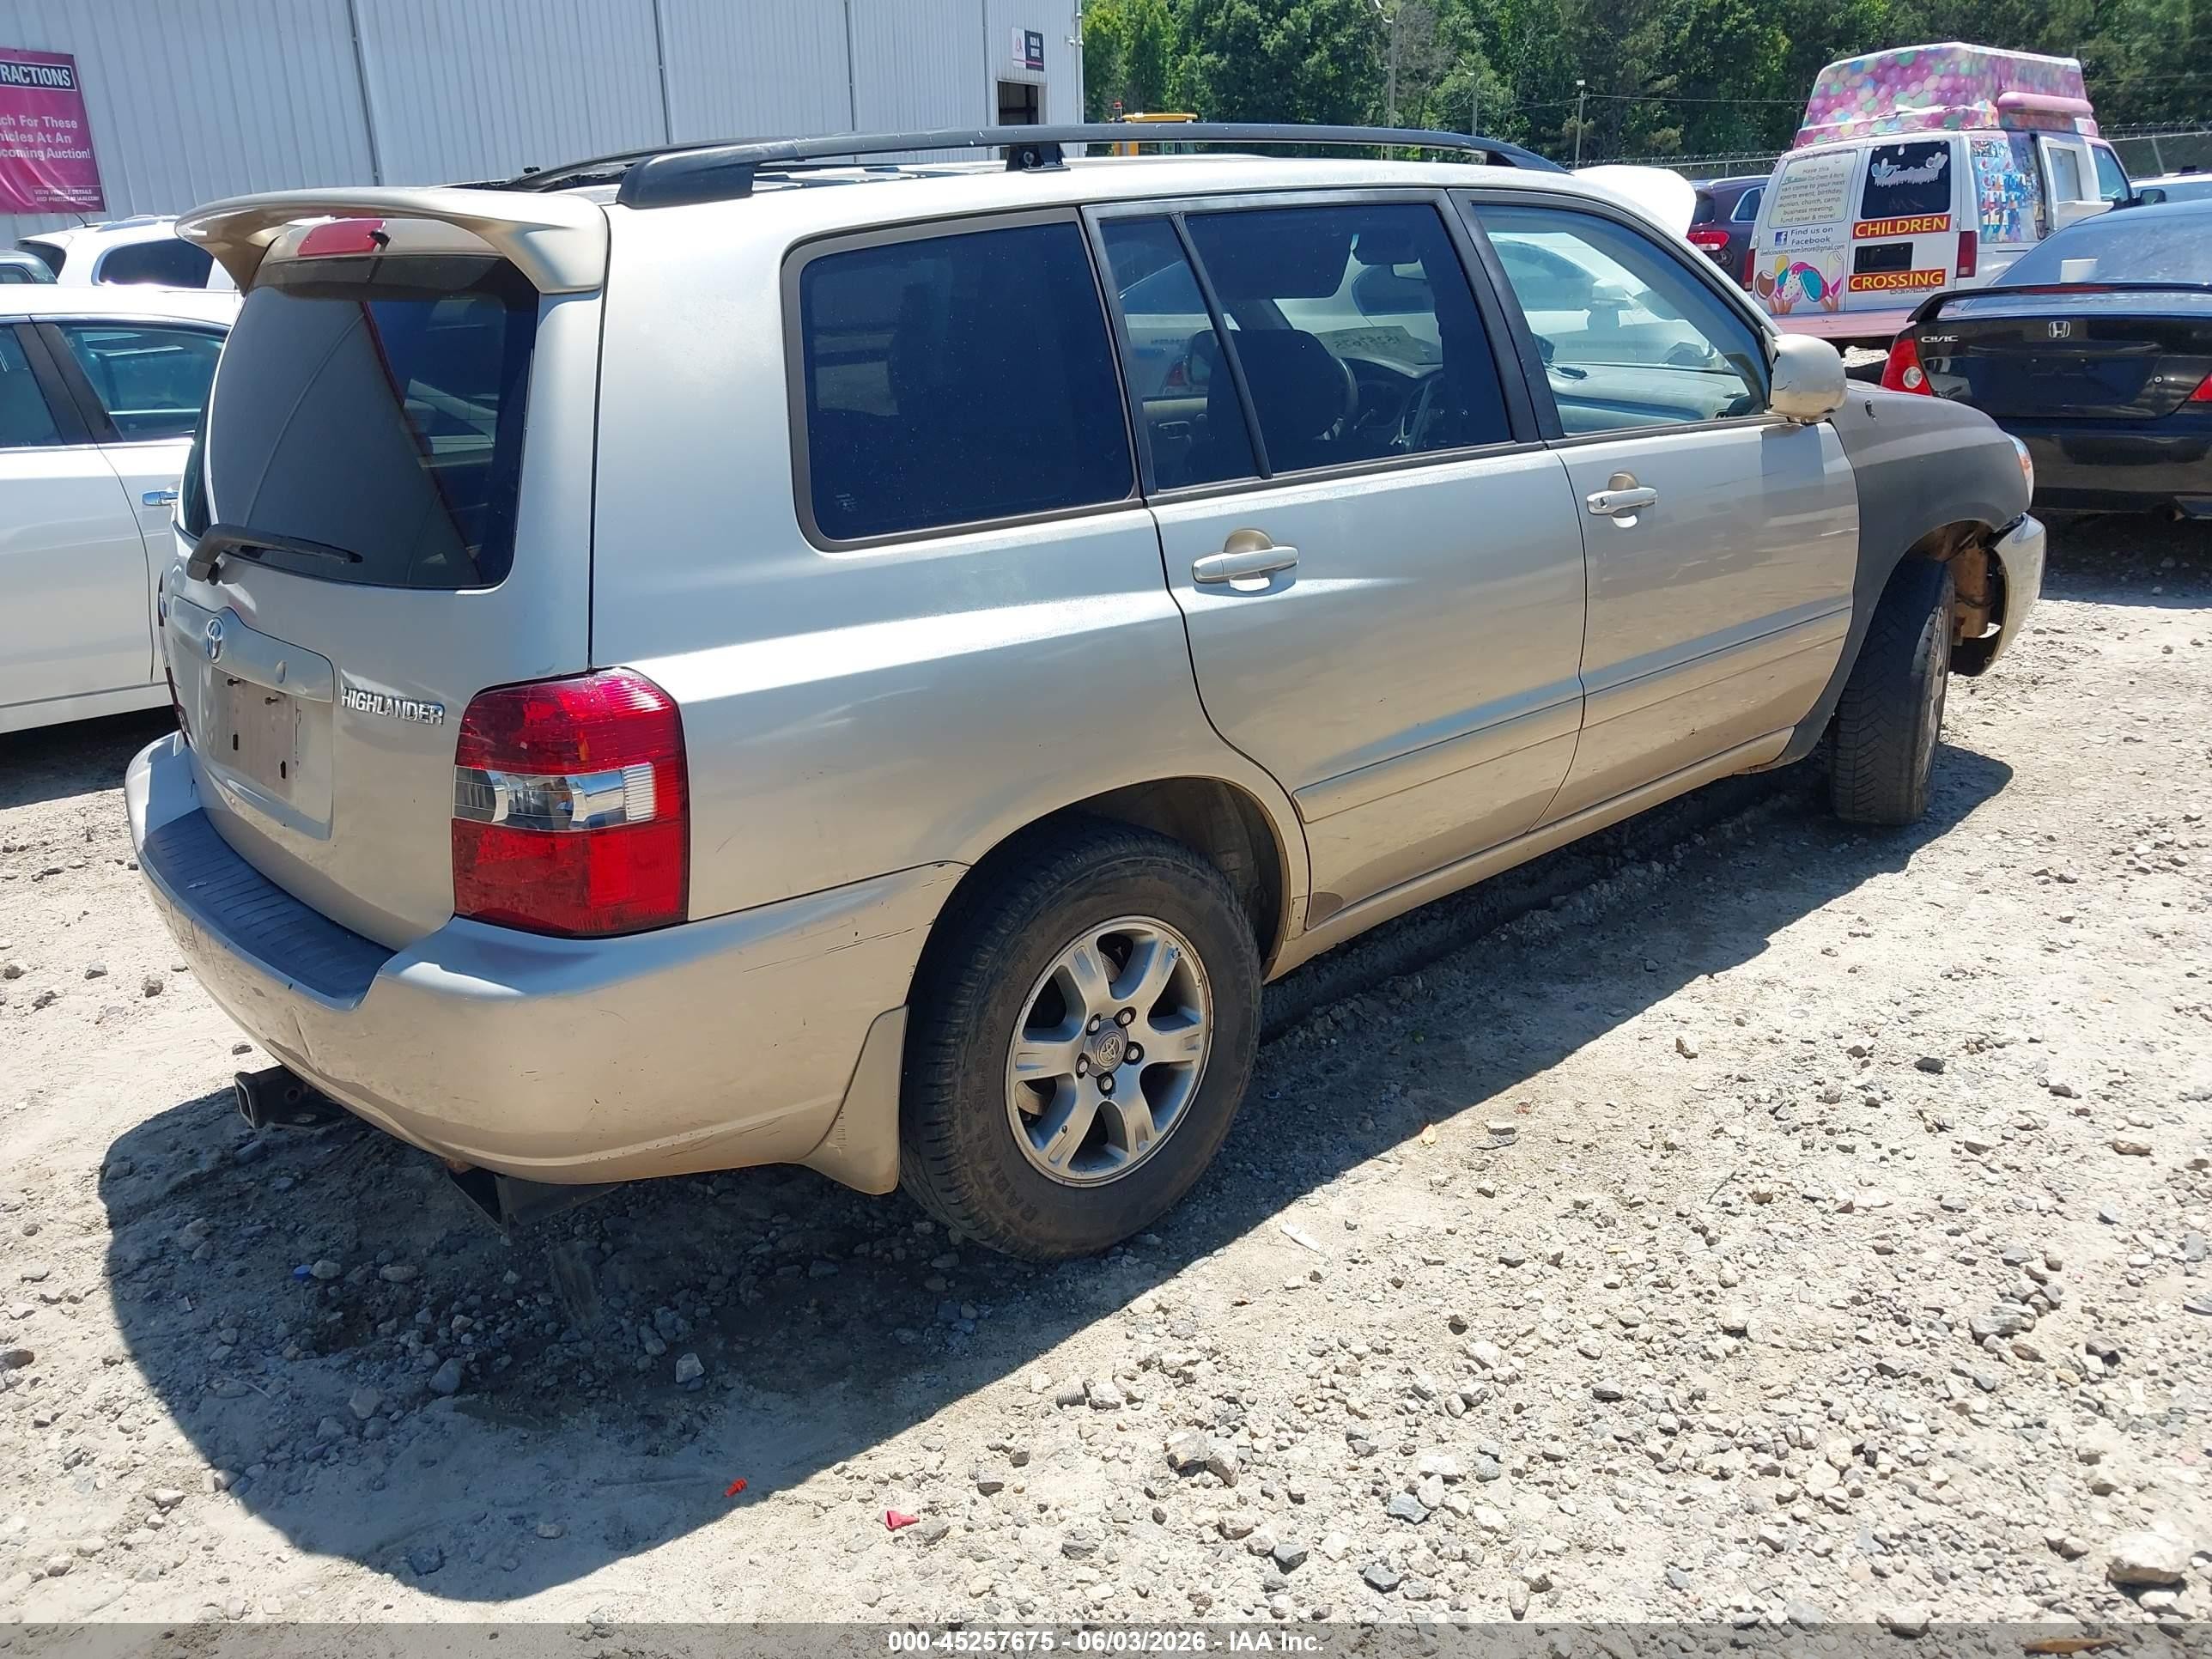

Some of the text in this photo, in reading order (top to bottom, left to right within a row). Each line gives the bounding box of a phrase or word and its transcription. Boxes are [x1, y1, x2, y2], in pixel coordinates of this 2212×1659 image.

[19, 115, 39, 128] For
[41, 116, 78, 129] These
[37, 132, 52, 143] At
[56, 132, 72, 143] An
[46, 147, 91, 159] Auction!
[1790, 228, 1808, 236] Find
[1855, 216, 1948, 238] CHILDREN
[1791, 235, 1831, 246] Facebook
[1850, 271, 1943, 290] CROSSING
[341, 687, 446, 726] HIGHLANDER
